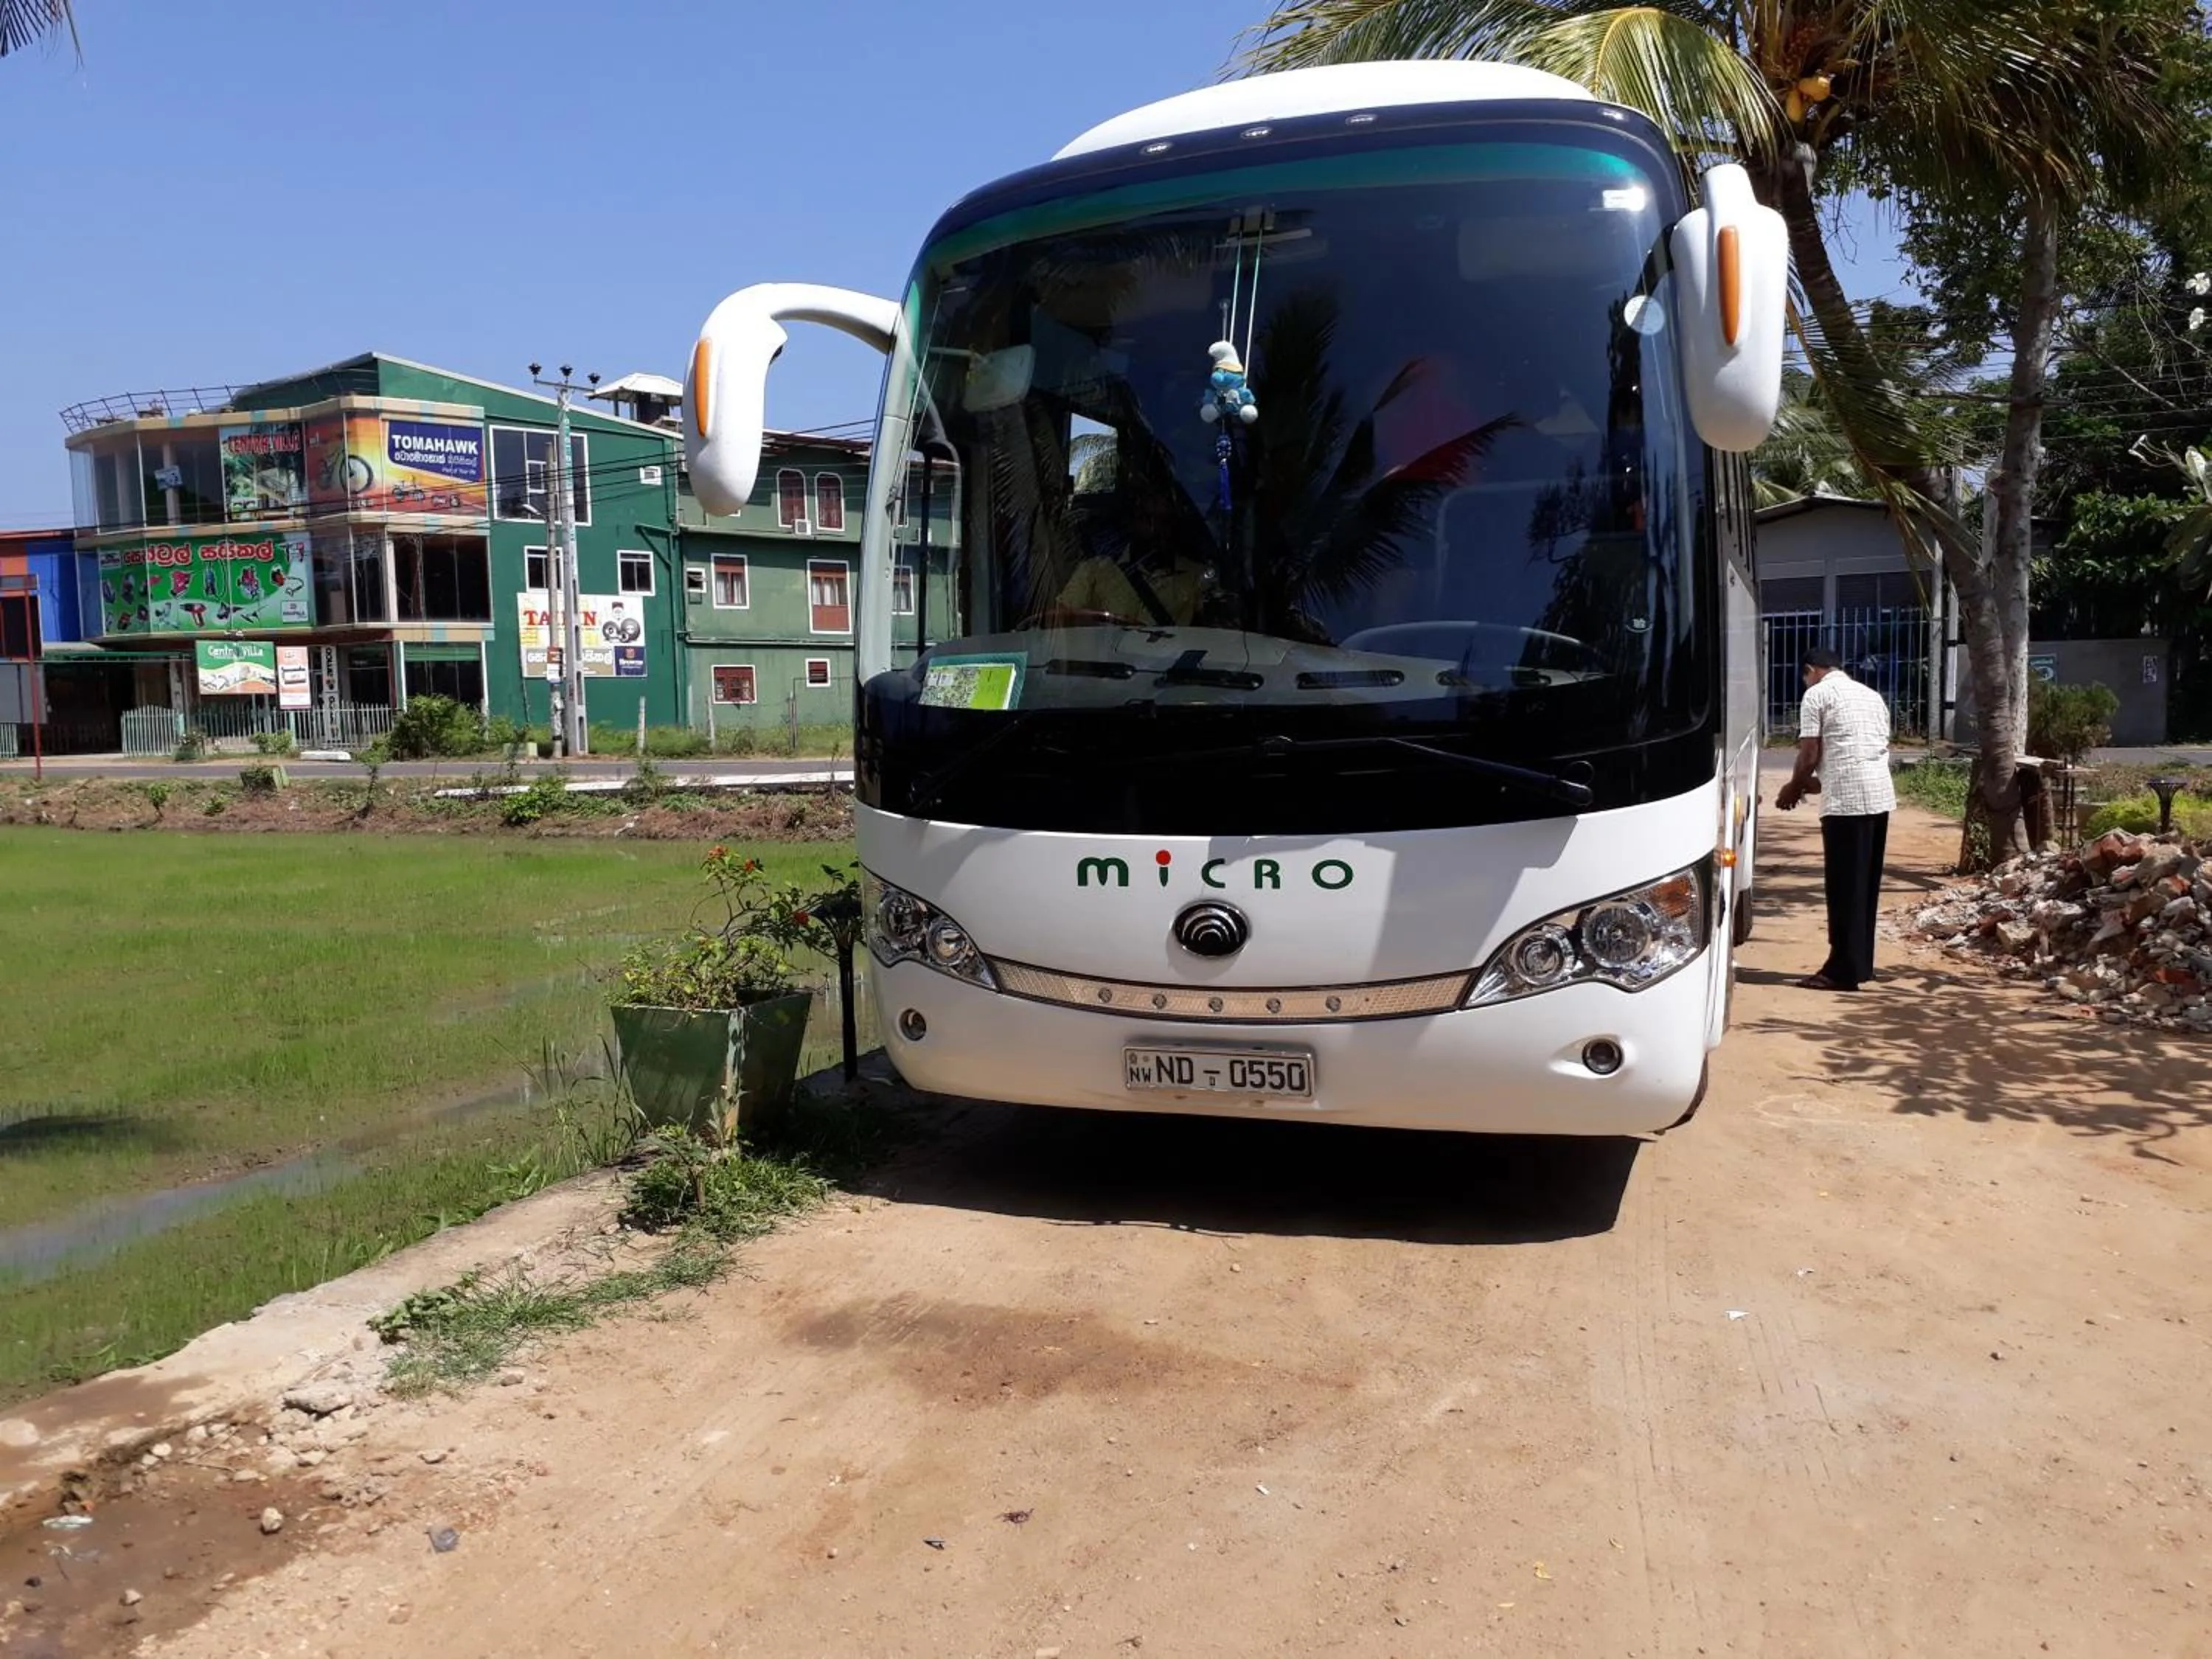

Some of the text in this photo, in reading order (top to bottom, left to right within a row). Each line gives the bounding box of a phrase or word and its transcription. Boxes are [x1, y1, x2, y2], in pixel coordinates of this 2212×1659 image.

[392, 434, 479, 455] TOMAHAWK
[1130, 1068, 1151, 1083] NW
[1230, 1060, 1305, 1091] 0550
